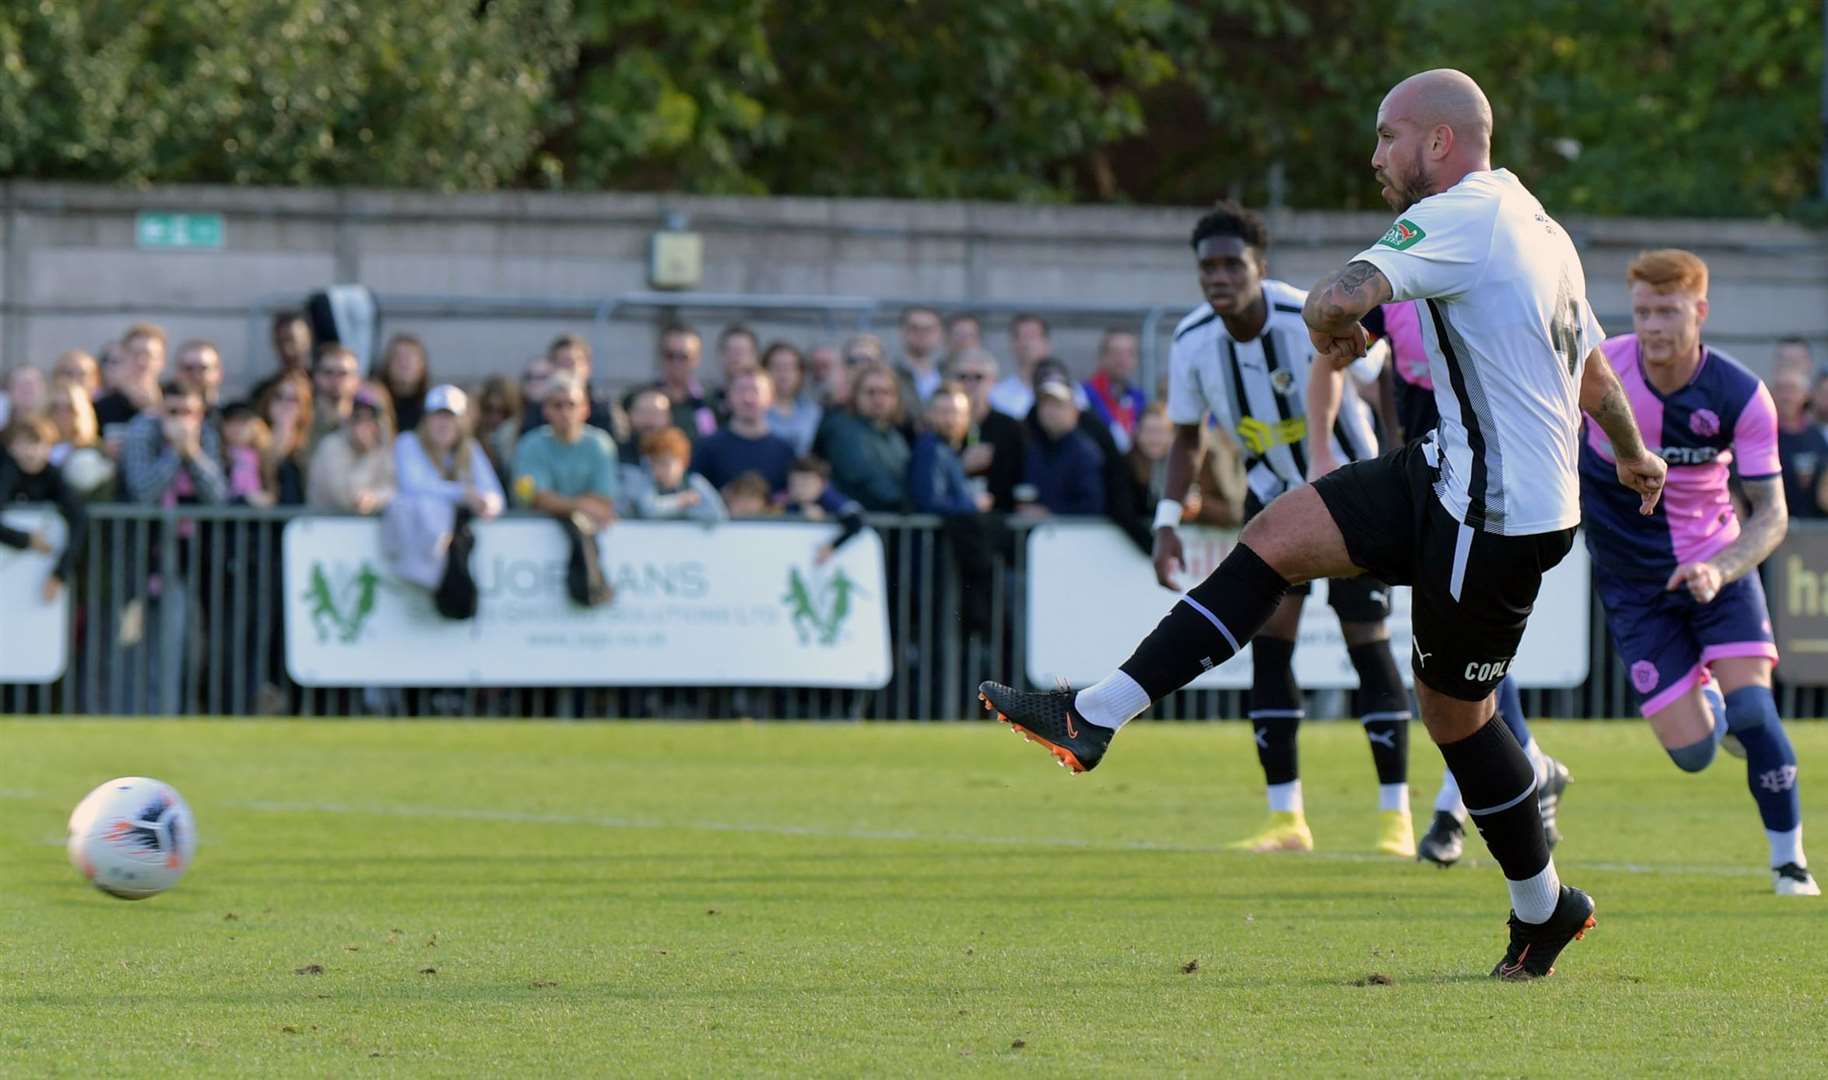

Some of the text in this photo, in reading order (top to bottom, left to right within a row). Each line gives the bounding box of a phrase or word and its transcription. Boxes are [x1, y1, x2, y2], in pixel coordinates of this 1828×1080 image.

[487, 559, 708, 598] JOANS
[1788, 554, 1828, 615] h
[1464, 660, 1509, 682] COPL
